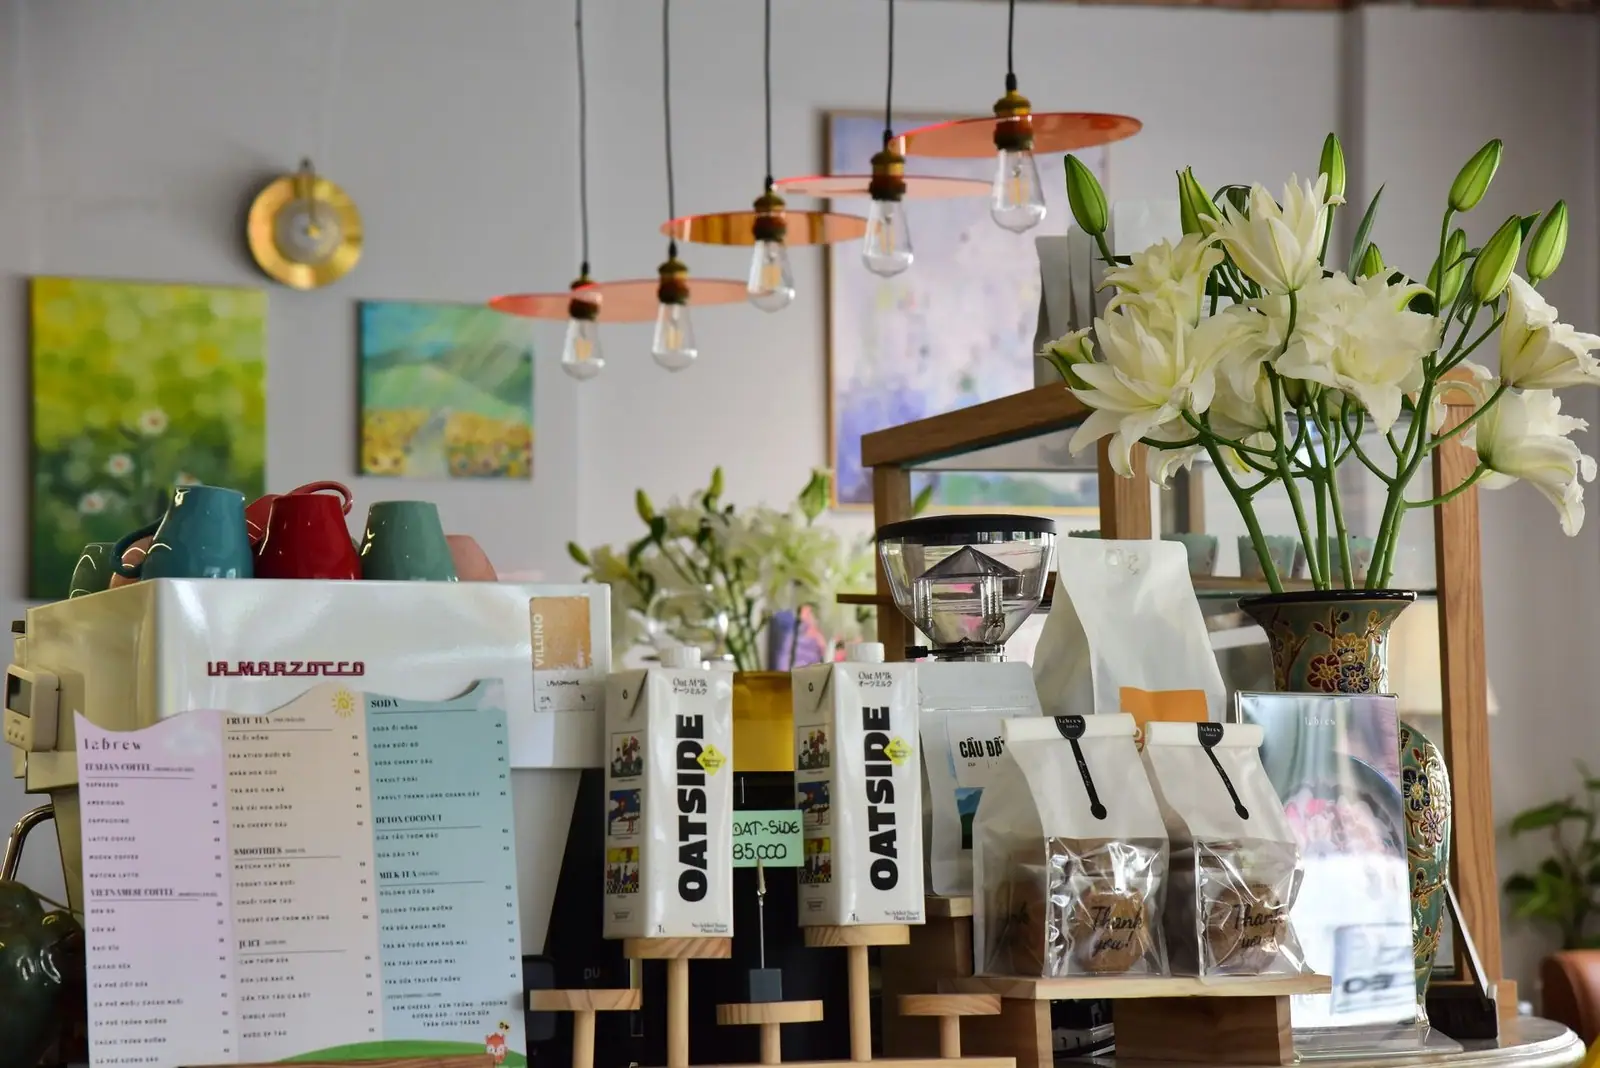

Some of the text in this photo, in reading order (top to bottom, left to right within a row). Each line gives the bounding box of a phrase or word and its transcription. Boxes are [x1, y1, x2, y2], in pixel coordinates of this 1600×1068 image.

[533, 613, 544, 668] VILLINO
[207, 661, 228, 676] LA
[371, 699, 399, 708] SODA
[959, 736, 985, 758] CẦU
[675, 714, 708, 902] OATSIDE
[862, 706, 899, 891] OATSIDE
[1091, 906, 1142, 931] Thank
